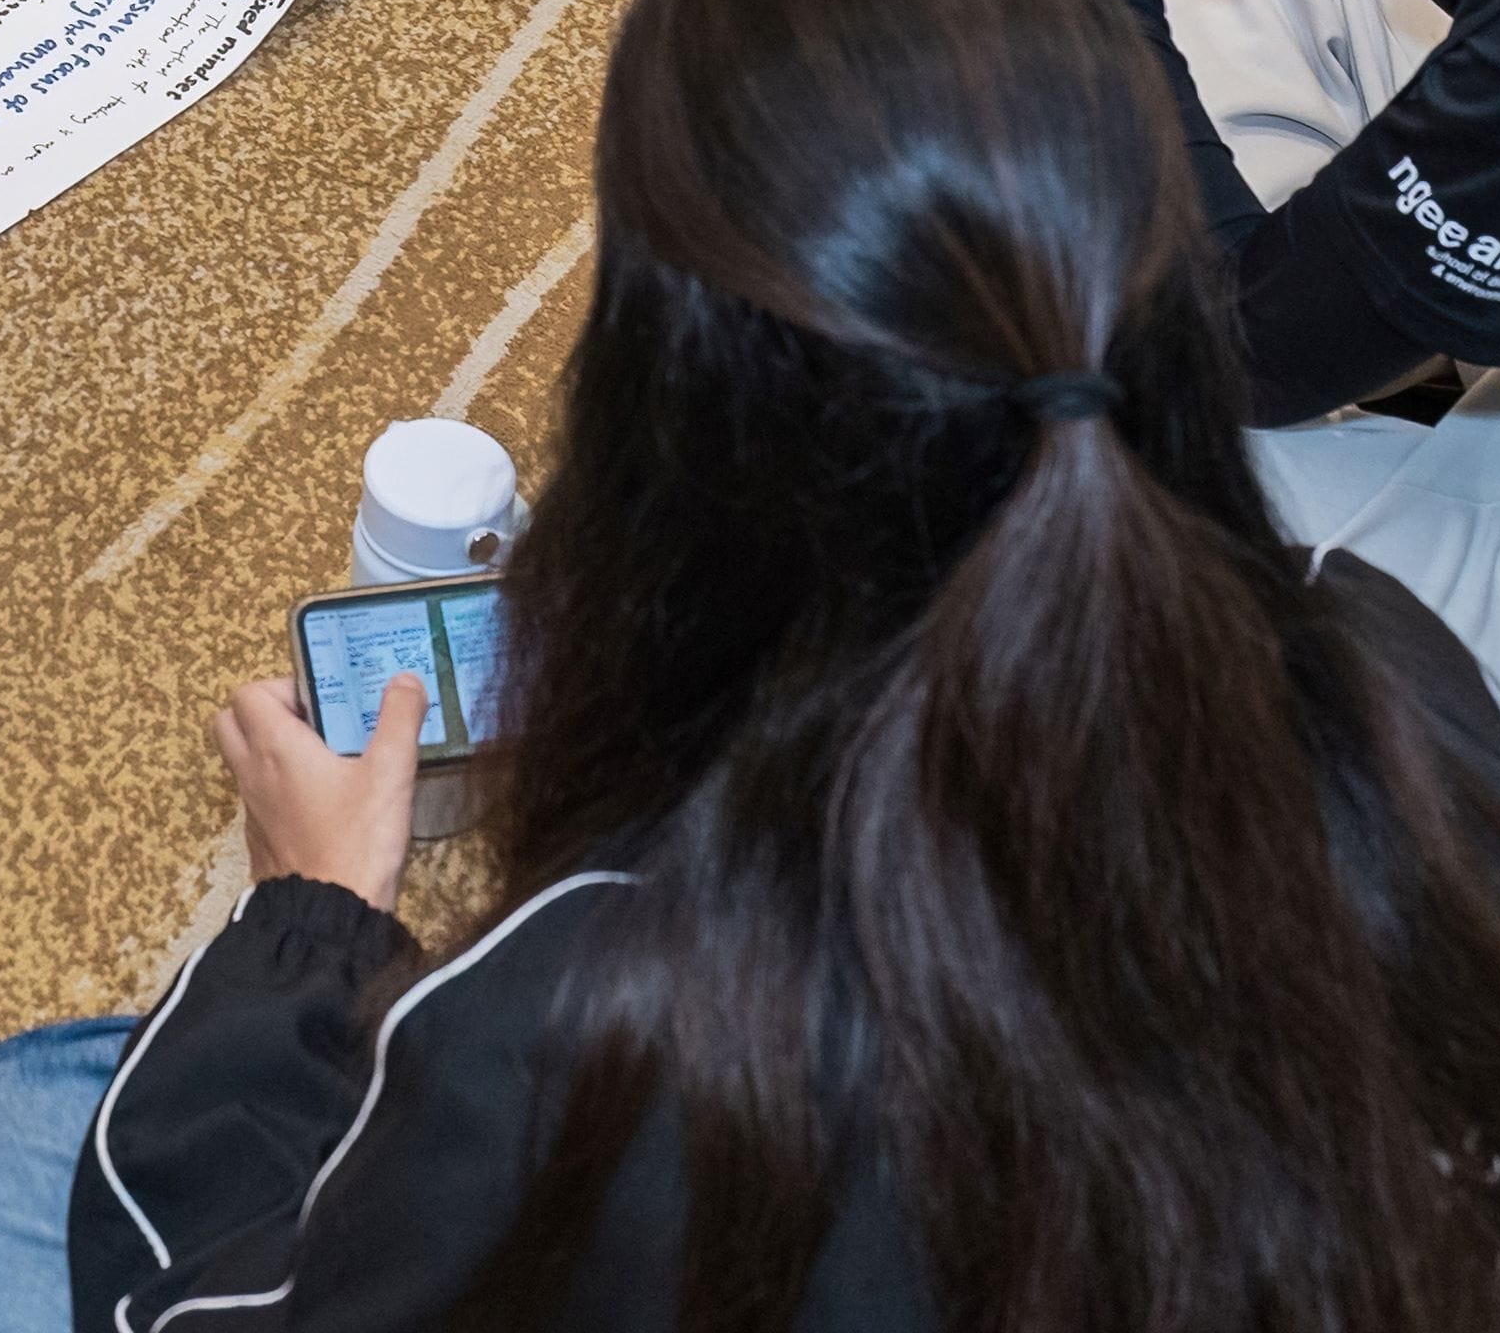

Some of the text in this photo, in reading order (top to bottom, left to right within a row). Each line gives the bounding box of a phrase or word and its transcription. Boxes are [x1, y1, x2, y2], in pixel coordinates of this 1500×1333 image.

[165, 35, 238, 101] mindset
[1, 93, 29, 114] of
[1387, 155, 1470, 249] ngee
